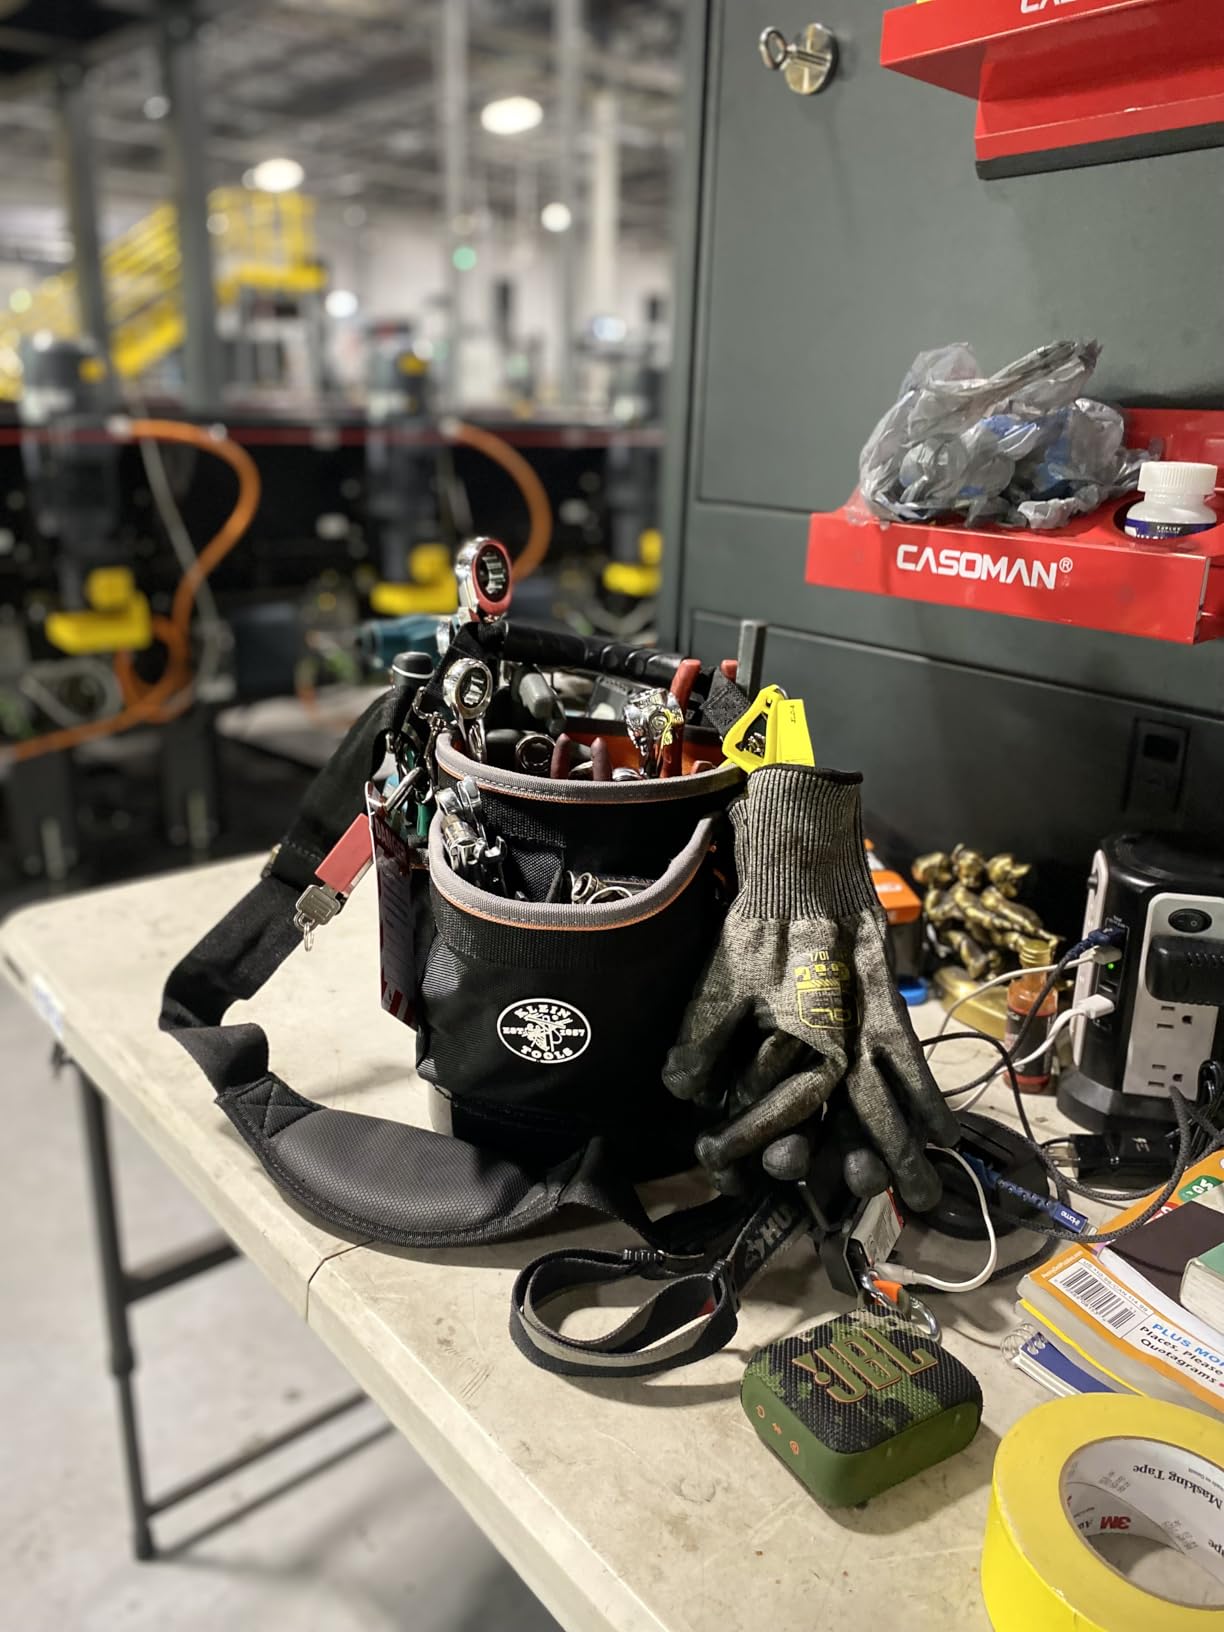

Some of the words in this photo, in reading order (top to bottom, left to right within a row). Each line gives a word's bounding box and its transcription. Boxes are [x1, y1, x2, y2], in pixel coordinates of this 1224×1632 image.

[514, 1004, 571, 1019] KLEIN
[520, 1044, 573, 1060] TOOLS
[1060, 1209, 1081, 1227] iHome
[1152, 1323, 1192, 1347] PLUS
[1140, 1326, 1179, 1352] Places,
[1182, 1350, 1224, 1376] Please
[1140, 1338, 1217, 1384] Quotagrams
[814, 1328, 938, 1403] JBL
[1132, 1463, 1165, 1481] Tape
[1168, 1471, 1224, 1511] Masking
[1100, 1515, 1131, 1530] 3M
